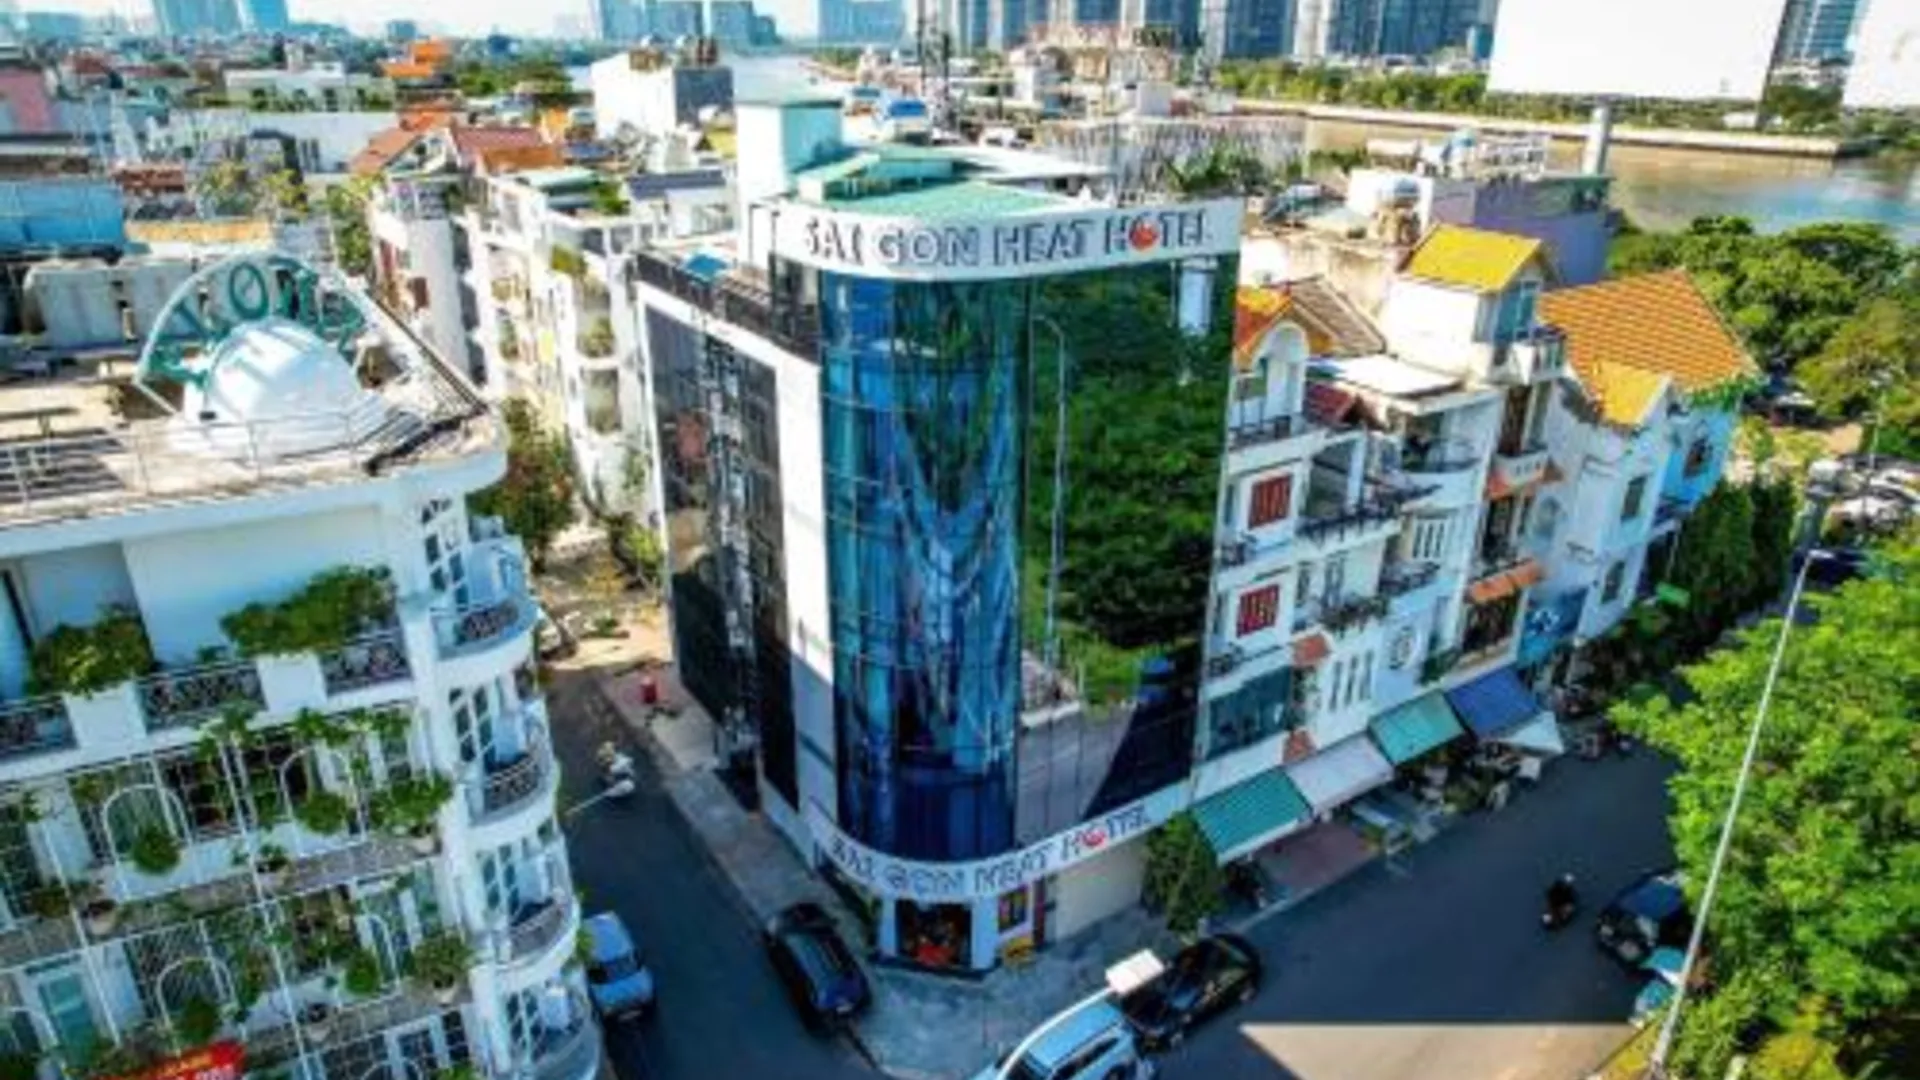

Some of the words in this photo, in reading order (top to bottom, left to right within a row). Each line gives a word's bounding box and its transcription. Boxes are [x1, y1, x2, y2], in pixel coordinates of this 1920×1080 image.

[804, 214, 863, 266] SAI
[873, 222, 980, 267] GON
[992, 217, 1095, 266] HEAT
[1104, 208, 1214, 254] HOTEL
[885, 866, 966, 896] GON
[973, 842, 1054, 894] HEAT
[1061, 803, 1150, 862] HOTEL
